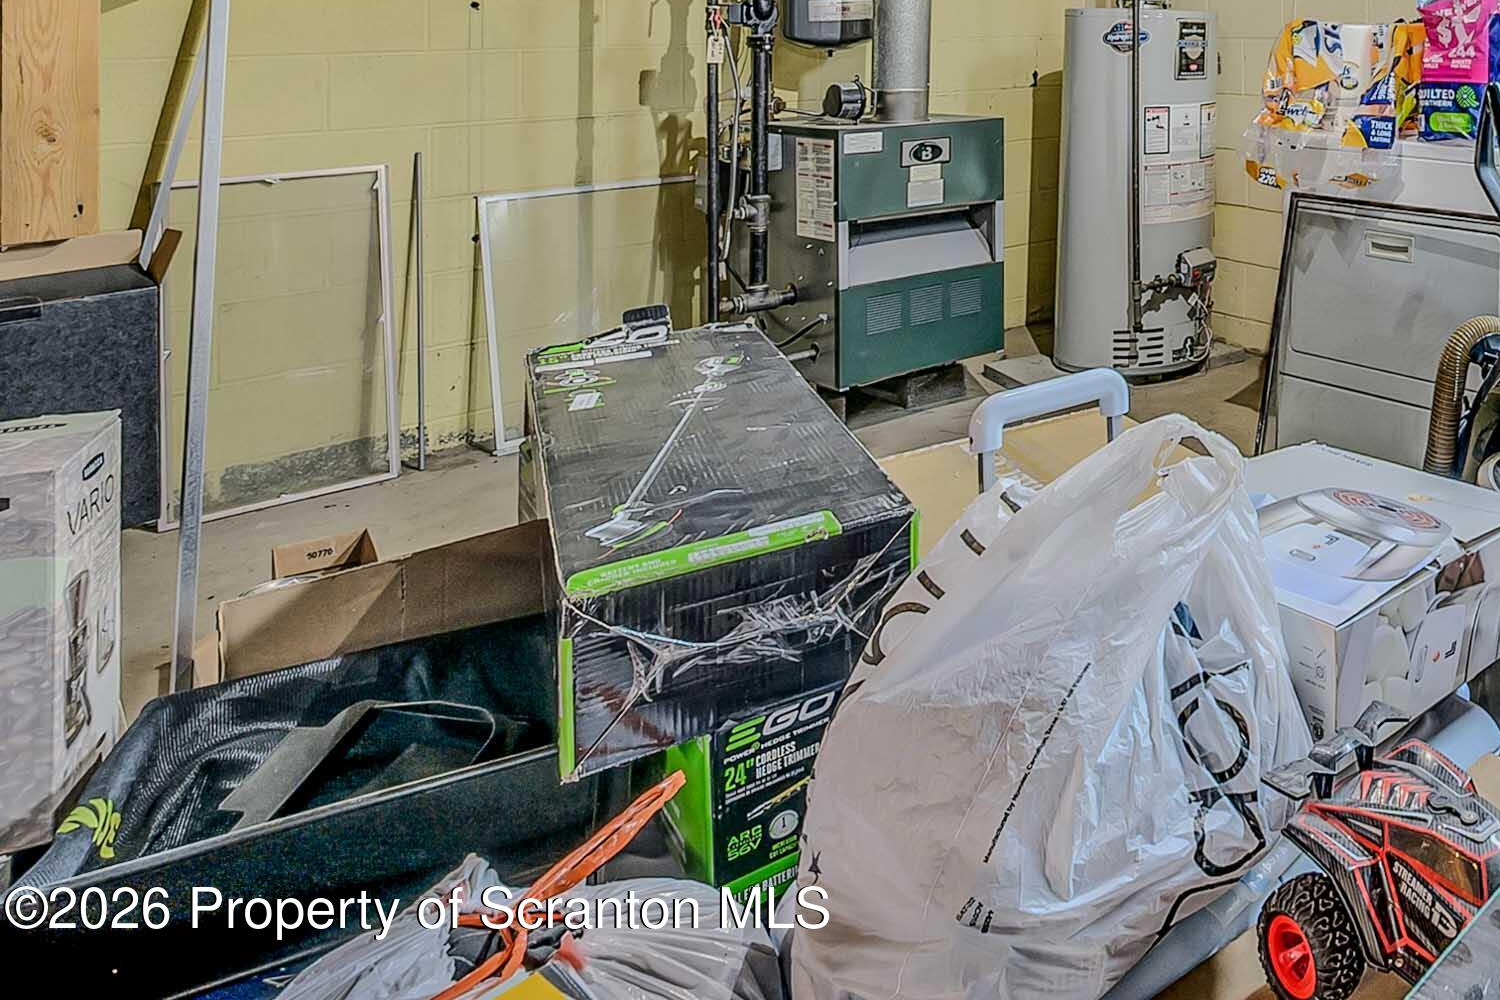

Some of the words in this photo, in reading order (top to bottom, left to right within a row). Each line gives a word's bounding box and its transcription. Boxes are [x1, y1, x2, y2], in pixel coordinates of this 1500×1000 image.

[1370, 120, 1393, 131] THICK
[67, 474, 115, 535] VARIO
[725, 690, 836, 752] EGO
[755, 755, 783, 779] HEDGE
[756, 741, 797, 767] CORDLESS
[1392, 860, 1433, 907] STREAMER
[1400, 881, 1431, 920] RACING
